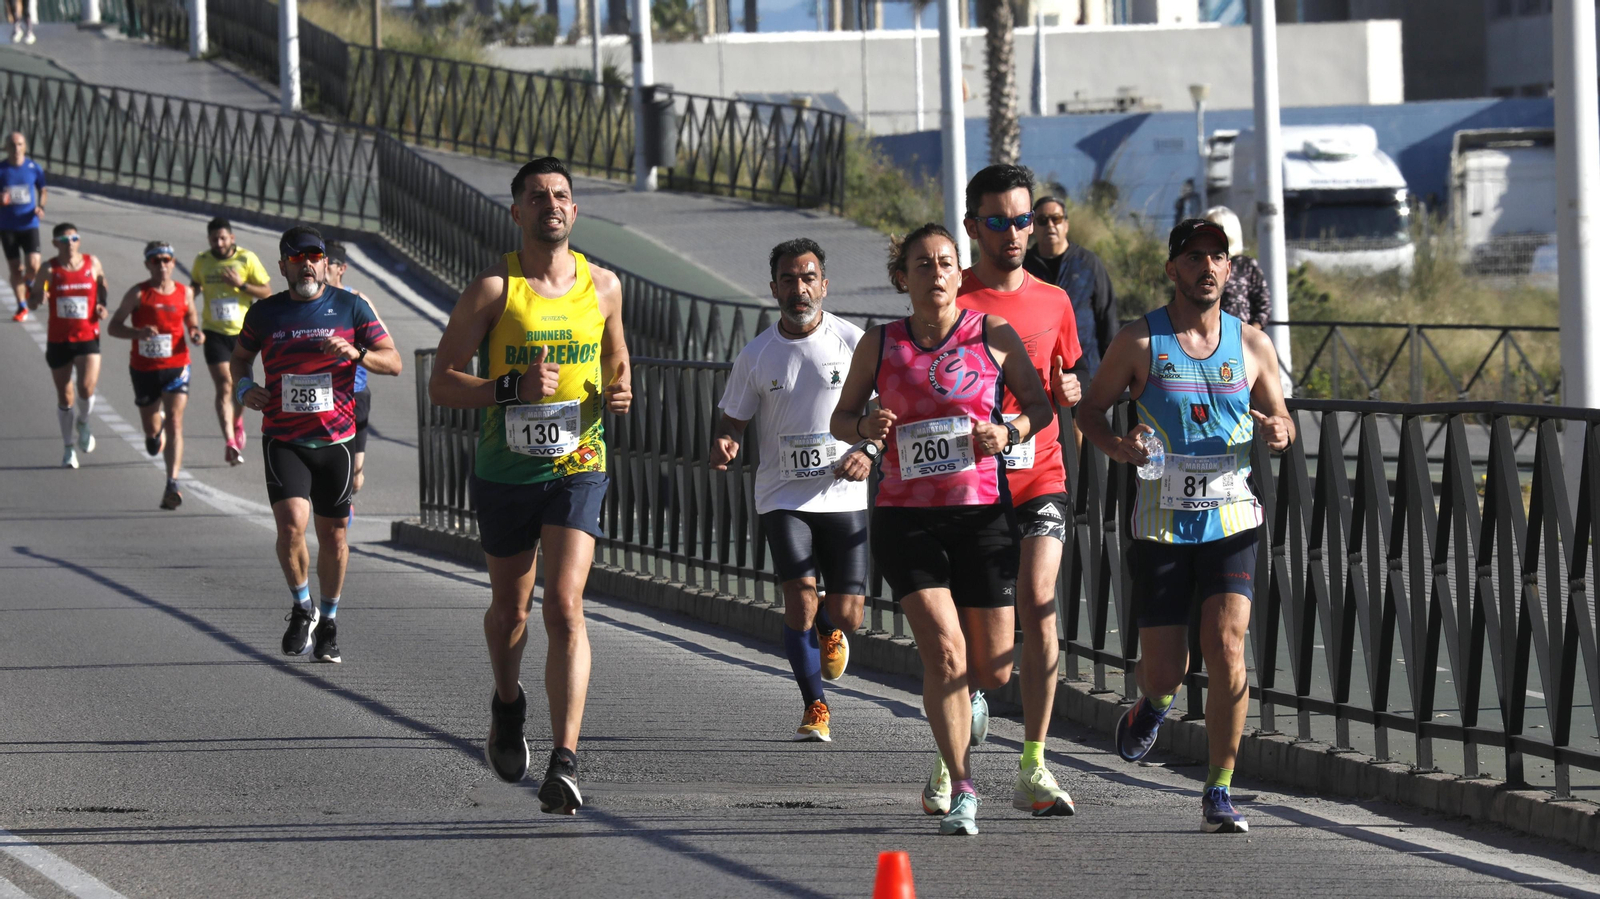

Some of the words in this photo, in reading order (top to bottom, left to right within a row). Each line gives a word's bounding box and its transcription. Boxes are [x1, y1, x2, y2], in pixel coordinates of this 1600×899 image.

[71, 282, 92, 290] PEDRO
[526, 329, 573, 342] RUNNERS
[505, 340, 598, 365] BARREÑOS
[929, 352, 949, 389] ALGECIRAS
[290, 388, 317, 403] 258
[522, 422, 559, 445] 130
[528, 447, 565, 455] EVOS
[911, 437, 949, 465] 260
[790, 449, 821, 469] 103
[795, 470, 826, 478] EVOS
[918, 463, 957, 474] EVOS
[1183, 475, 1208, 498] 81
[1181, 501, 1219, 509] EVOS
